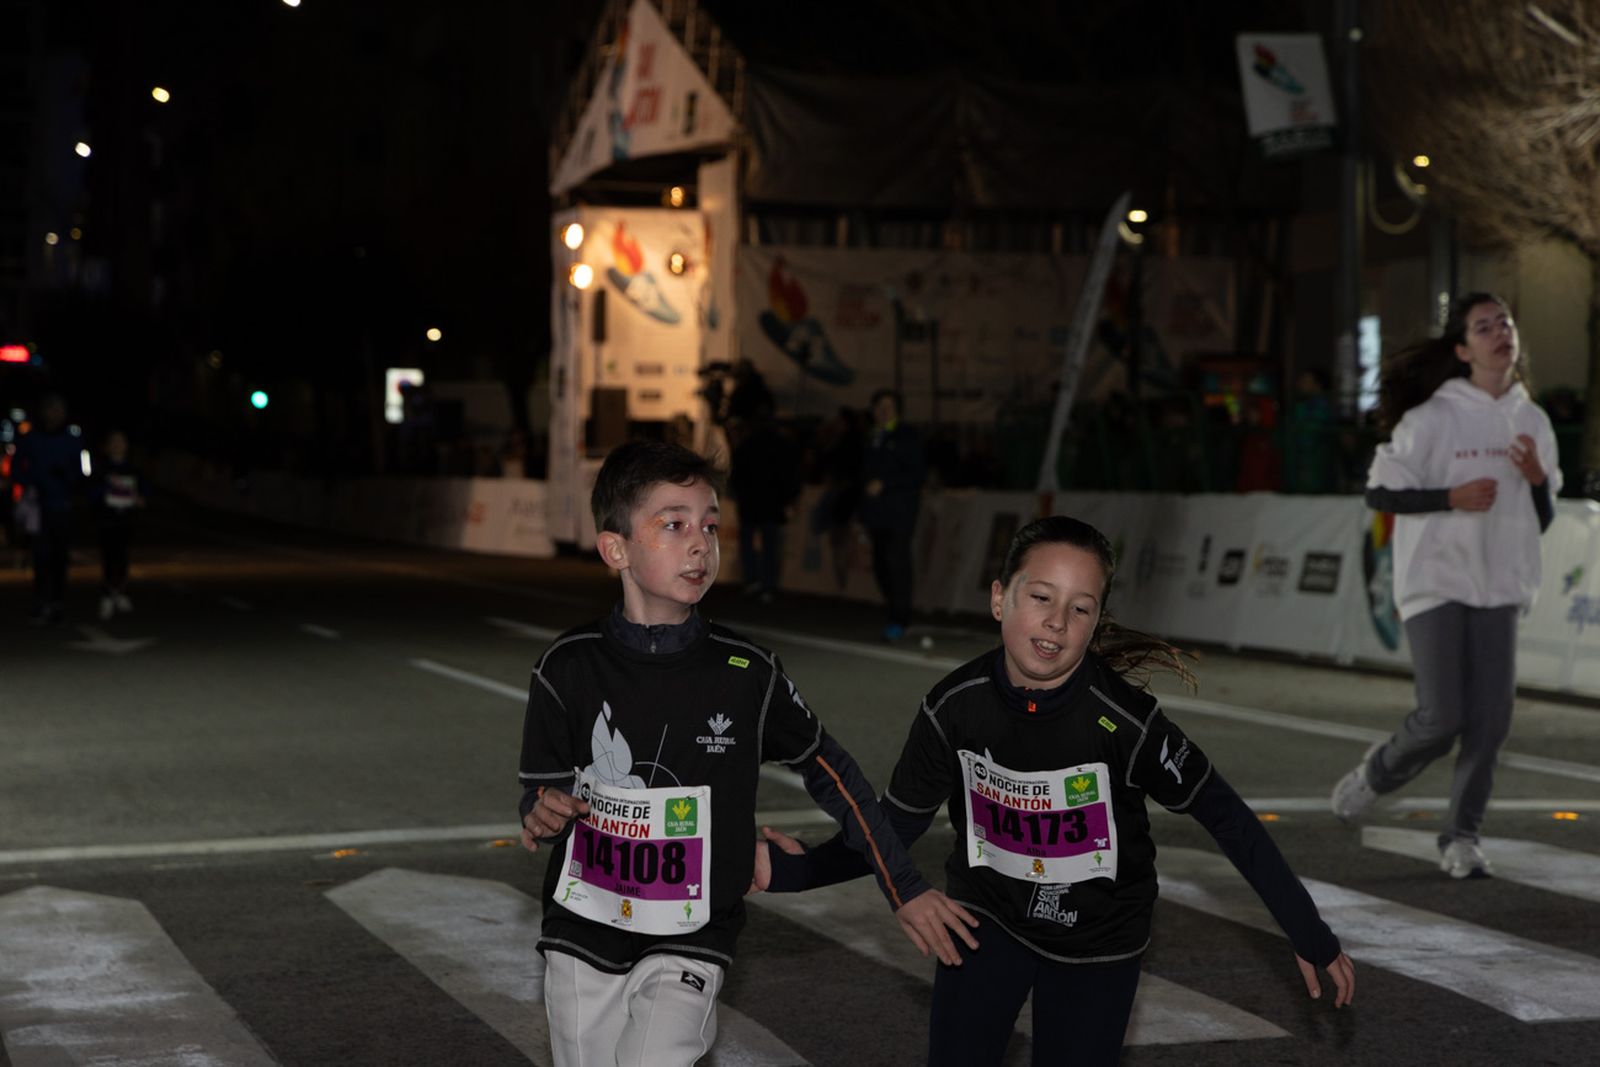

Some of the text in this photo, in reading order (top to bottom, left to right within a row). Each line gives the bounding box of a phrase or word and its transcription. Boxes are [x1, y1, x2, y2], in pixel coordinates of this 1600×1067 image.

[706, 744, 726, 754] JAÉN
[974, 765, 987, 778] 43
[976, 782, 1052, 810] SAN ANTÓN
[989, 774, 1050, 796] NOCHE DE
[591, 796, 651, 819] NOCHE DE
[582, 812, 650, 838] AN ANTÓN
[986, 803, 1088, 846] 14173
[583, 831, 686, 885] 14108
[613, 882, 641, 897] JAIME
[1033, 901, 1078, 924] ANTÓN
